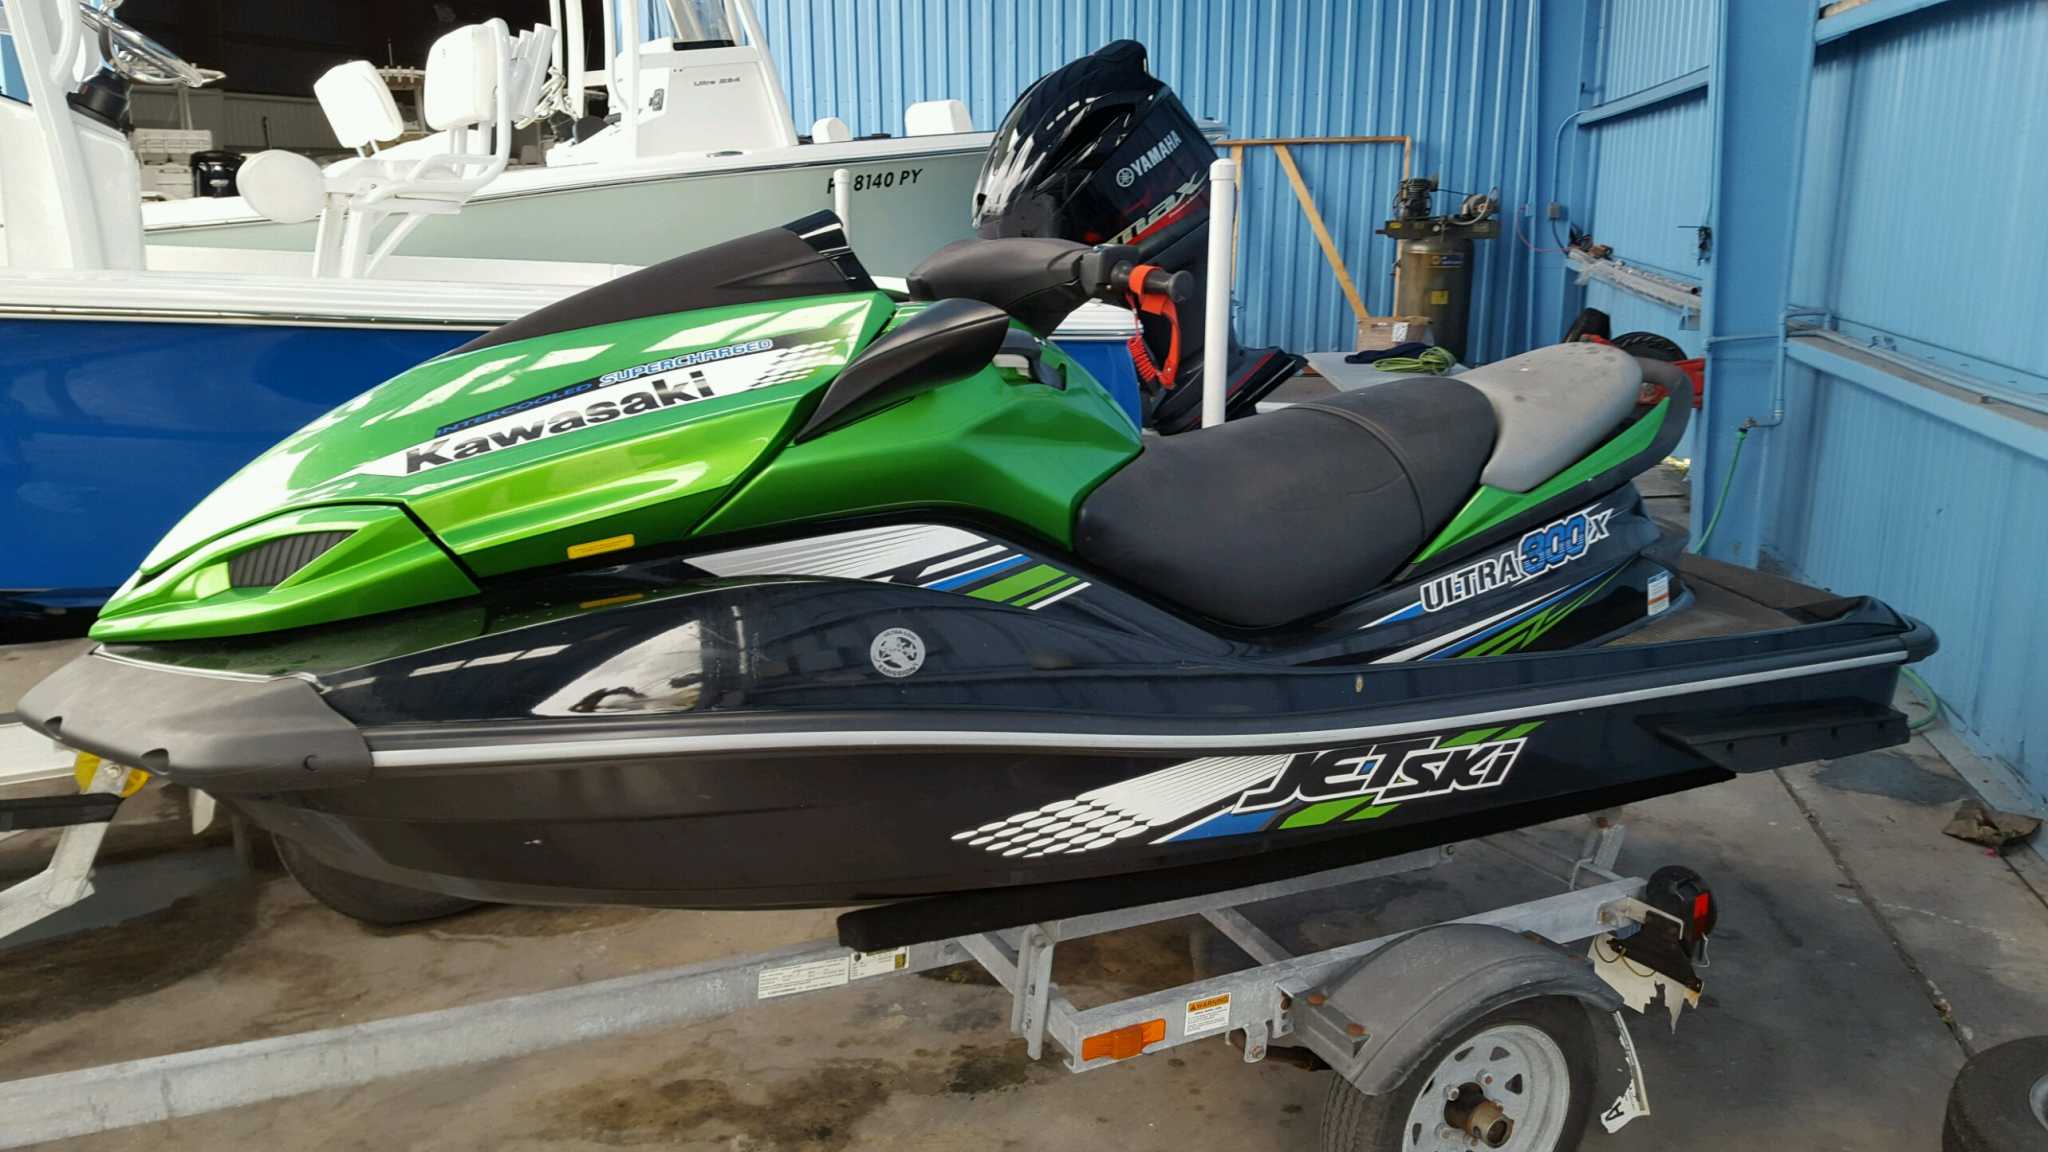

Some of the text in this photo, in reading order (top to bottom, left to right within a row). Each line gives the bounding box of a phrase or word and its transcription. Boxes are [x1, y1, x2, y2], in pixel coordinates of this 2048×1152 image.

[853, 171, 895, 192] 8140
[899, 168, 924, 186] PY
[1130, 129, 1182, 177] YAMAHA
[436, 338, 774, 437] INTERCOOLED SUPERCHARGED
[406, 370, 715, 474] Kawasaki
[1420, 550, 1522, 613] ULTRA
